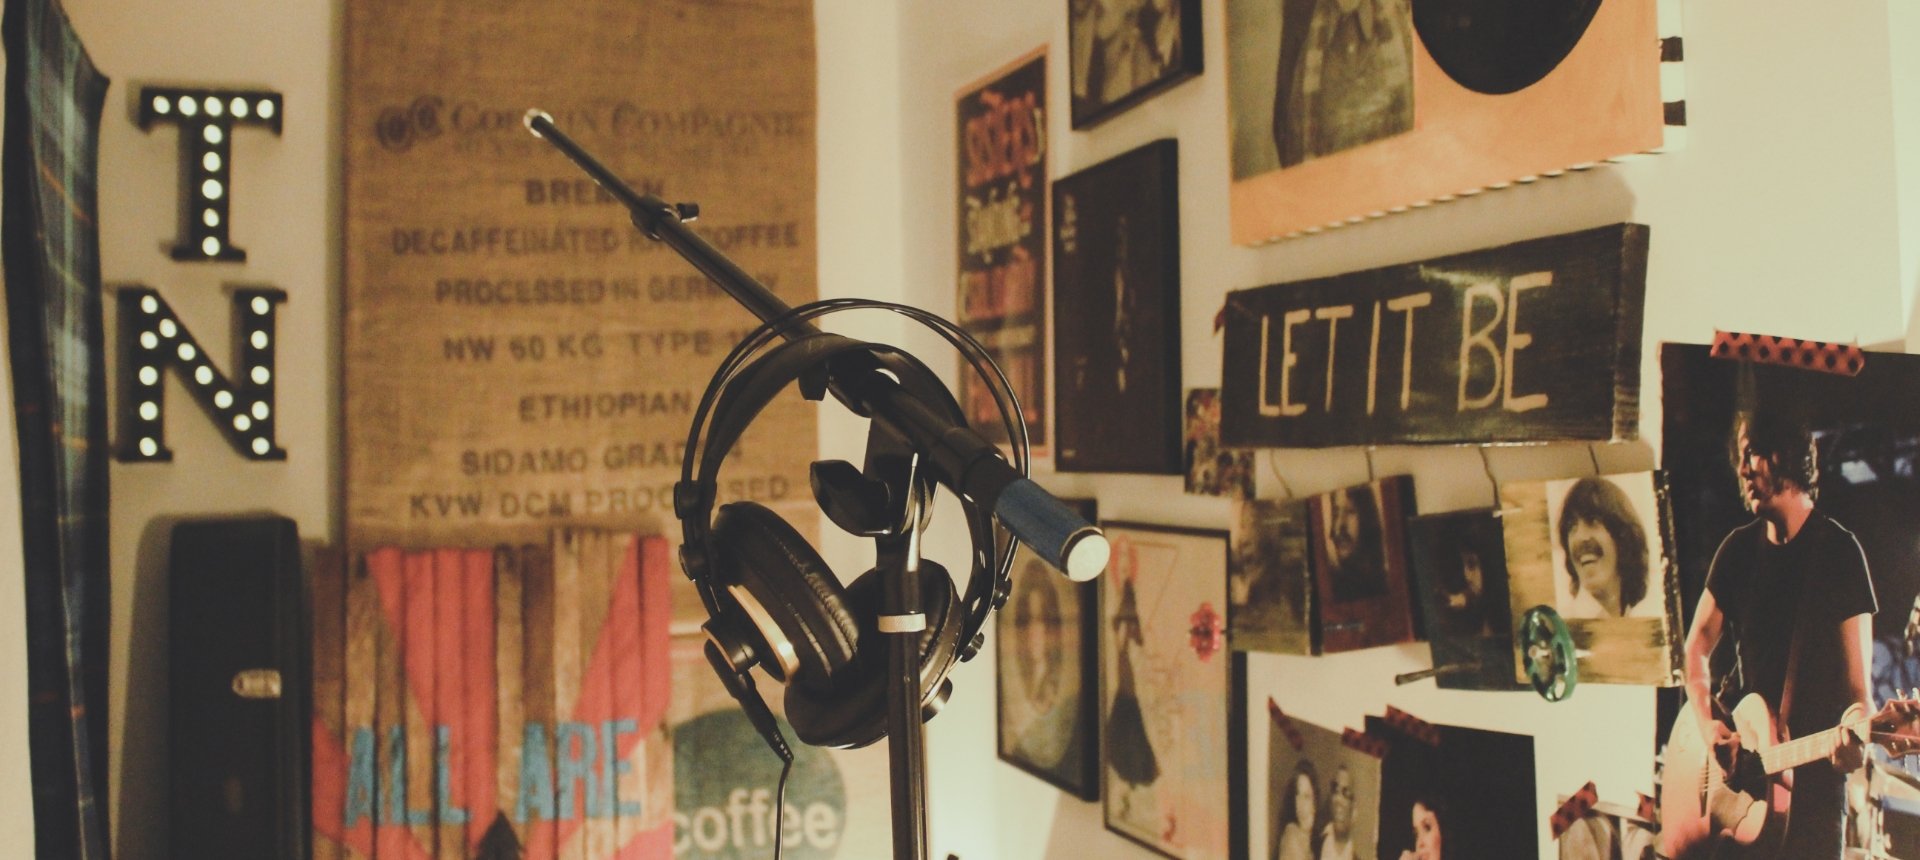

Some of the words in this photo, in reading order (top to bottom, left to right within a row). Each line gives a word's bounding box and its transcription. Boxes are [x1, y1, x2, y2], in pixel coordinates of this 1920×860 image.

[140, 86, 283, 261] T
[525, 179, 664, 204] BREMN
[435, 278, 605, 304] PROCESSED
[649, 272, 779, 301] GERMY
[443, 336, 495, 361] NW
[557, 331, 604, 358] KG
[627, 330, 712, 356] TYPE
[1259, 308, 1355, 416] LET
[1367, 291, 1432, 416] IT
[1458, 271, 1554, 413] BE
[112, 286, 288, 462] N
[518, 390, 692, 422] ETHIOPIAN
[461, 447, 588, 476] SIDAMO
[410, 492, 482, 519] KVW
[585, 474, 789, 514] PROCSED
[345, 723, 473, 829] ALL
[515, 718, 642, 824] ARE
[674, 787, 838, 854] coffee
